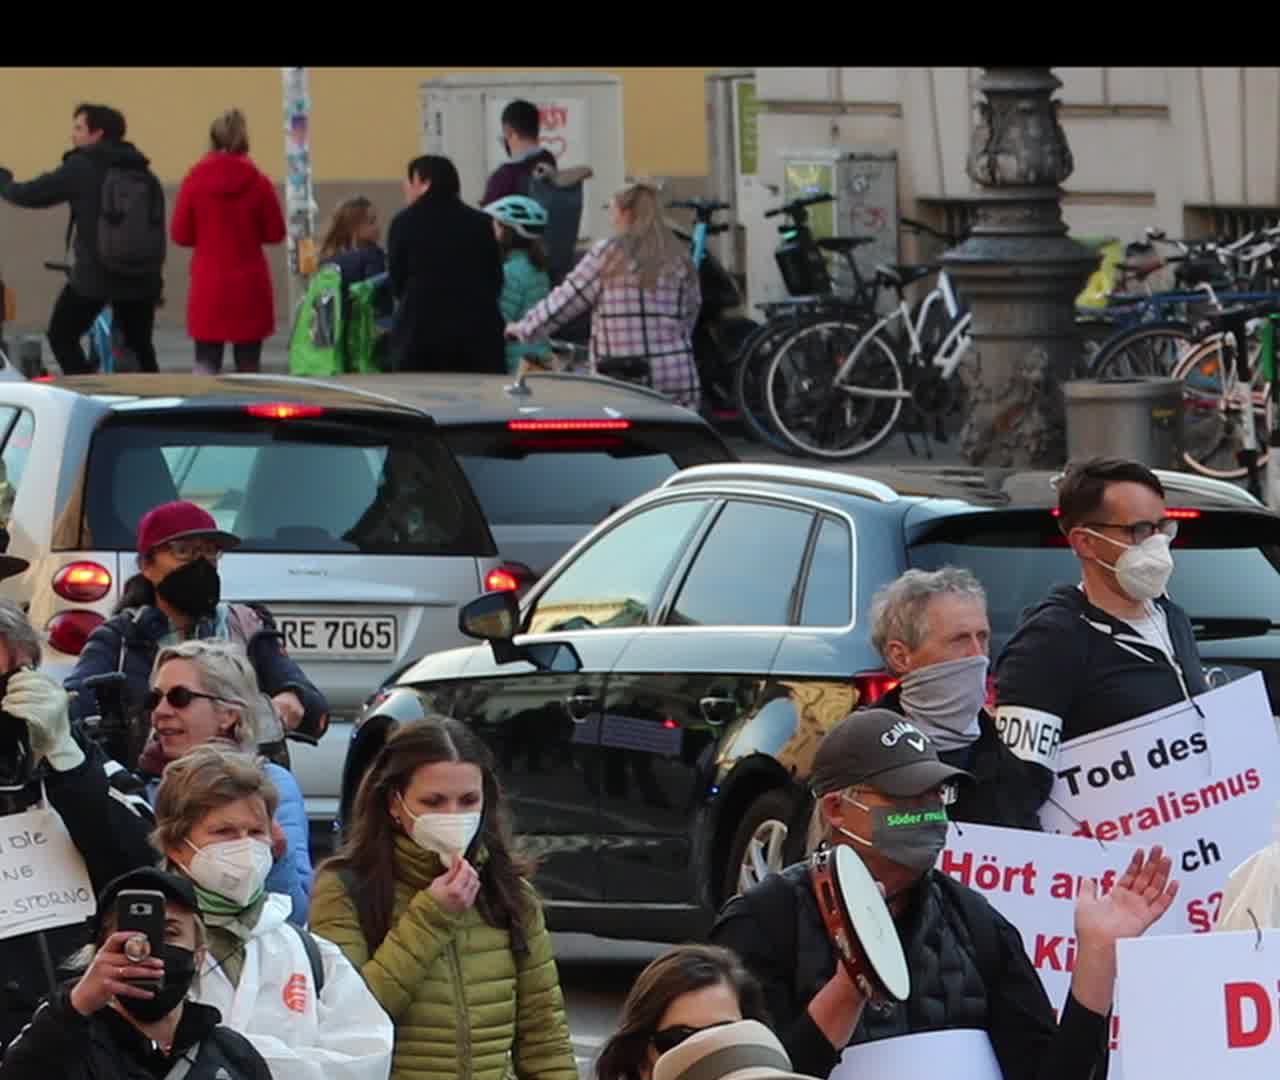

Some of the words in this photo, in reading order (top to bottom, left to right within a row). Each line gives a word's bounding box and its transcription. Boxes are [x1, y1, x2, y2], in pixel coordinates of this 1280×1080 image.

[324, 620, 392, 650] 7065
[1057, 749, 1136, 797] Tod
[1146, 731, 1209, 769] des
[1072, 767, 1261, 842] deralismus
[940, 849, 1036, 897] Hört
